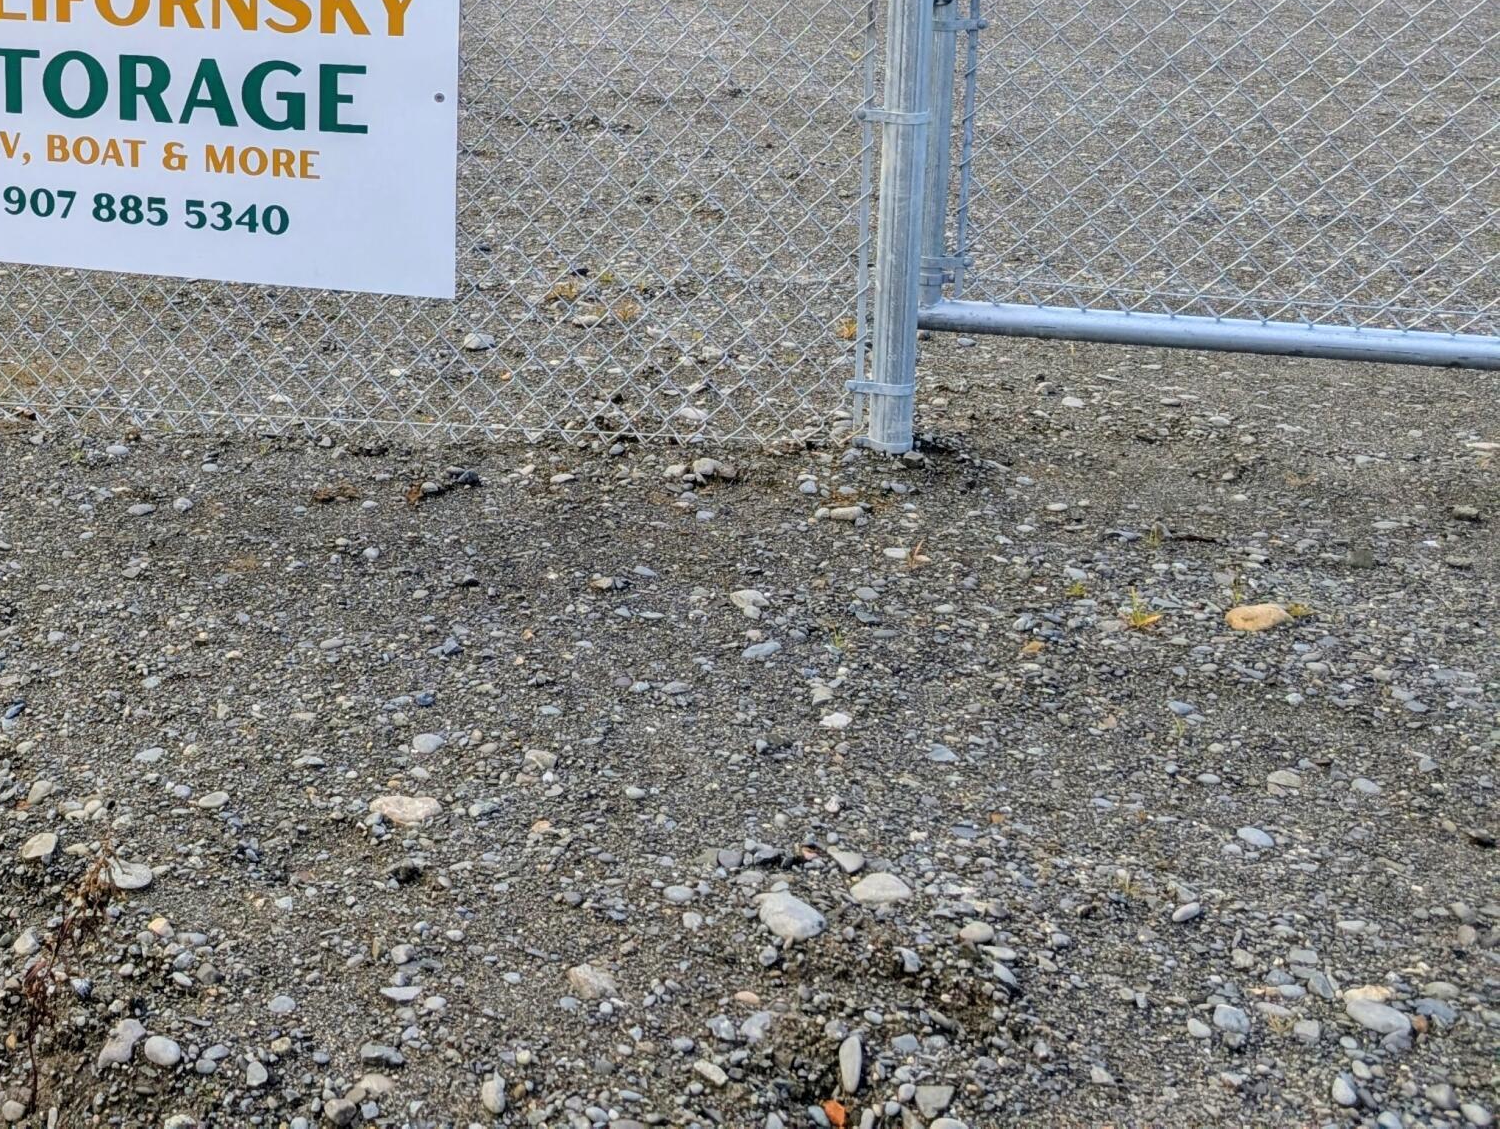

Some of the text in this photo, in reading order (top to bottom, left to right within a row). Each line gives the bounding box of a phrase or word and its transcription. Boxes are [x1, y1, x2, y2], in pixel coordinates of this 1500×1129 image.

[46, 134, 146, 168] BOAT
[162, 141, 188, 171] &
[205, 144, 321, 180] MORE
[2, 185, 290, 236] 907 885 5340
